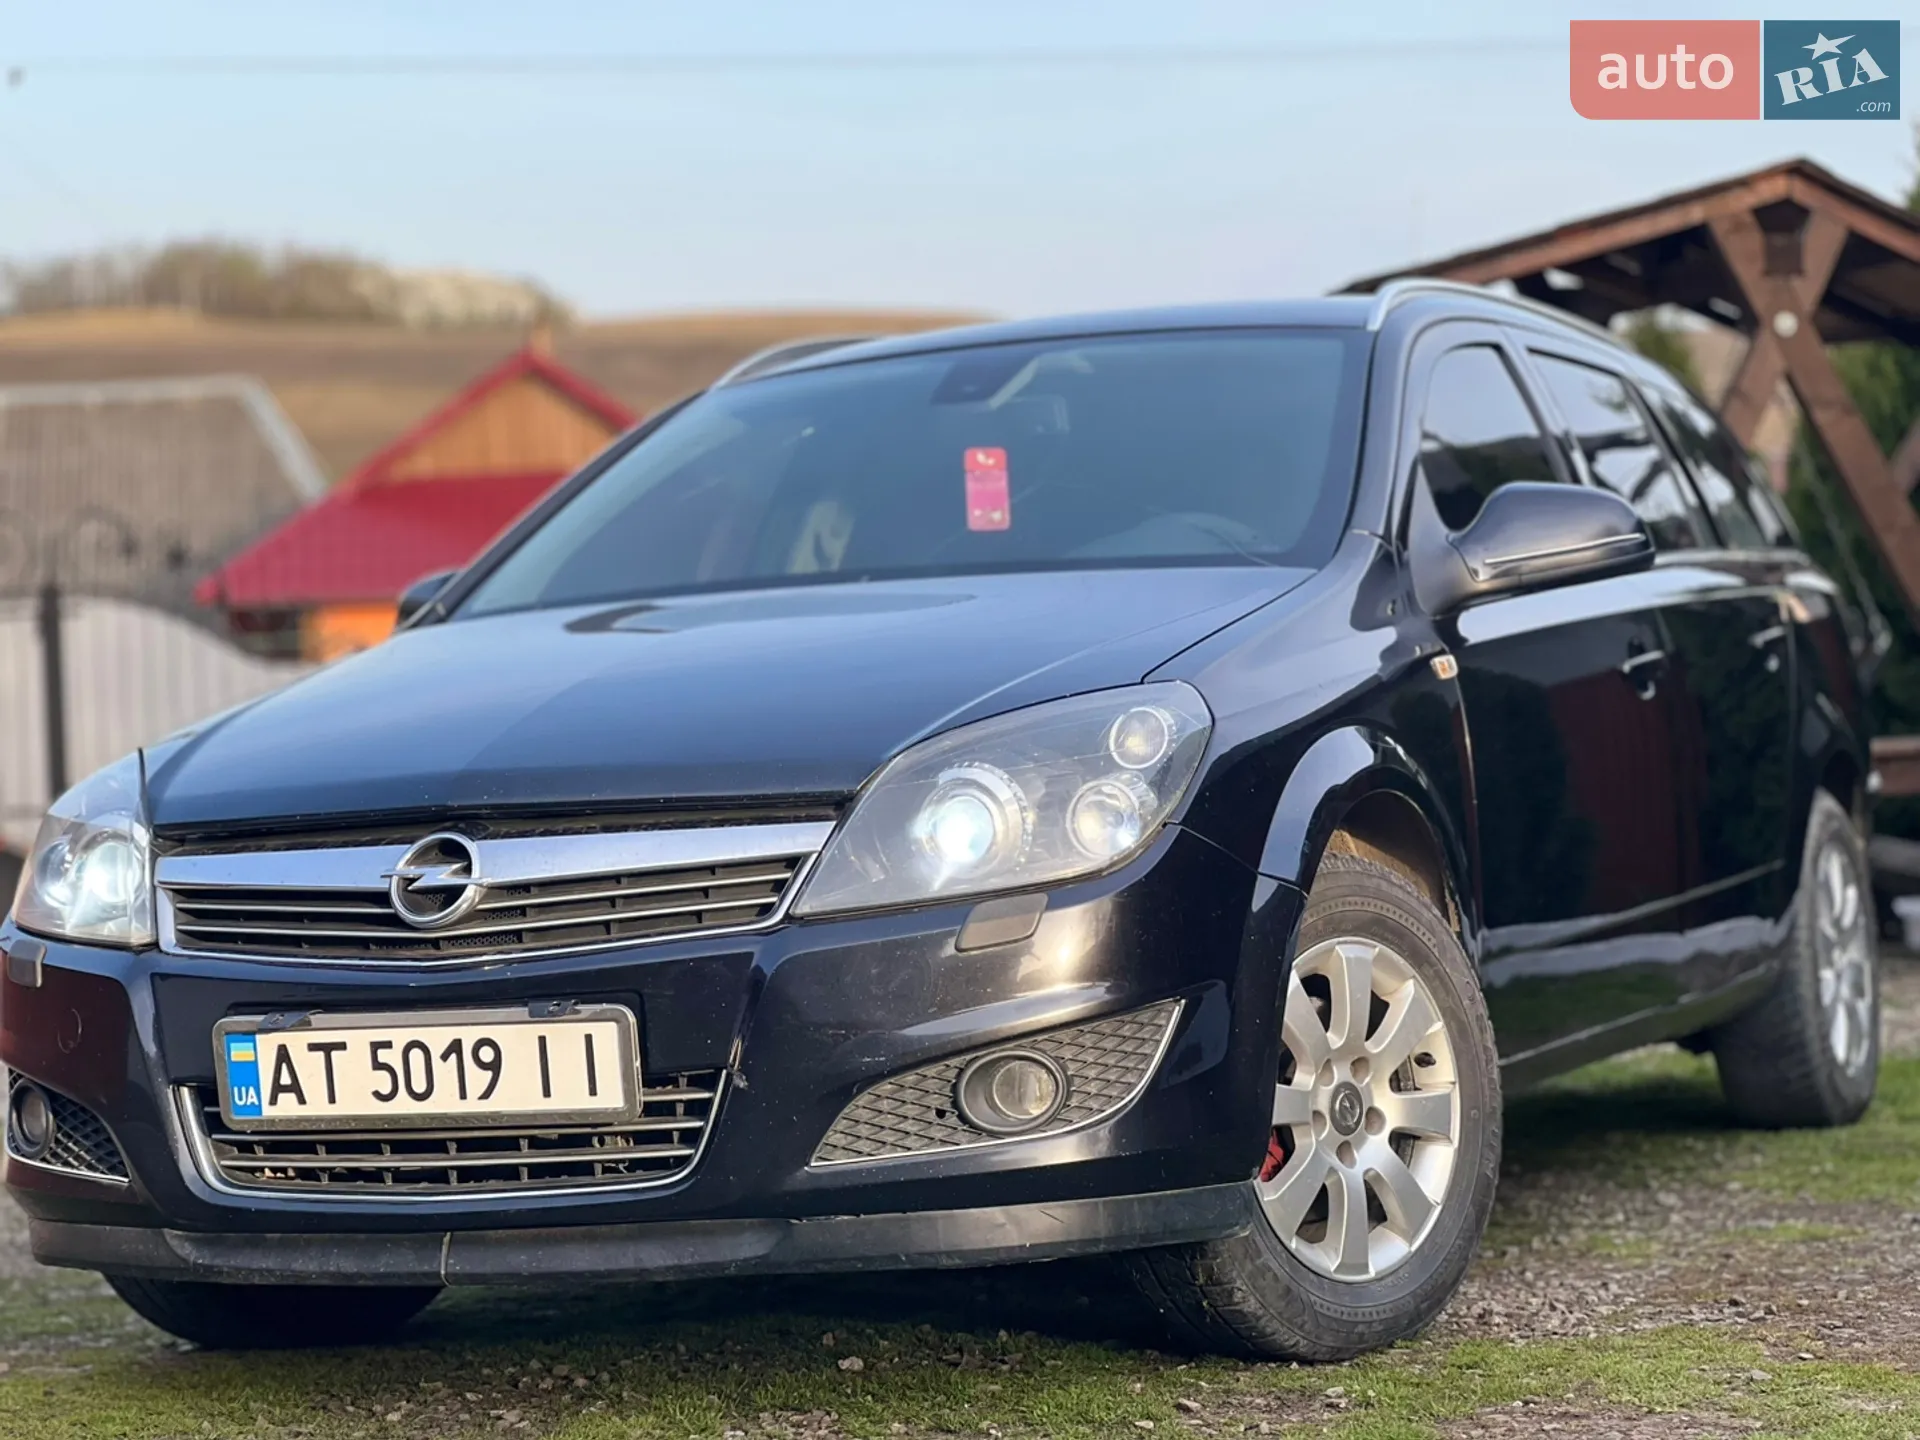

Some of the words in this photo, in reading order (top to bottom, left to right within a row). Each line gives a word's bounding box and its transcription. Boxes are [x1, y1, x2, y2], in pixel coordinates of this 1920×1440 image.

[268, 1041, 347, 1107] AT
[369, 1036, 503, 1102] 5019
[234, 1086, 259, 1106] UA
